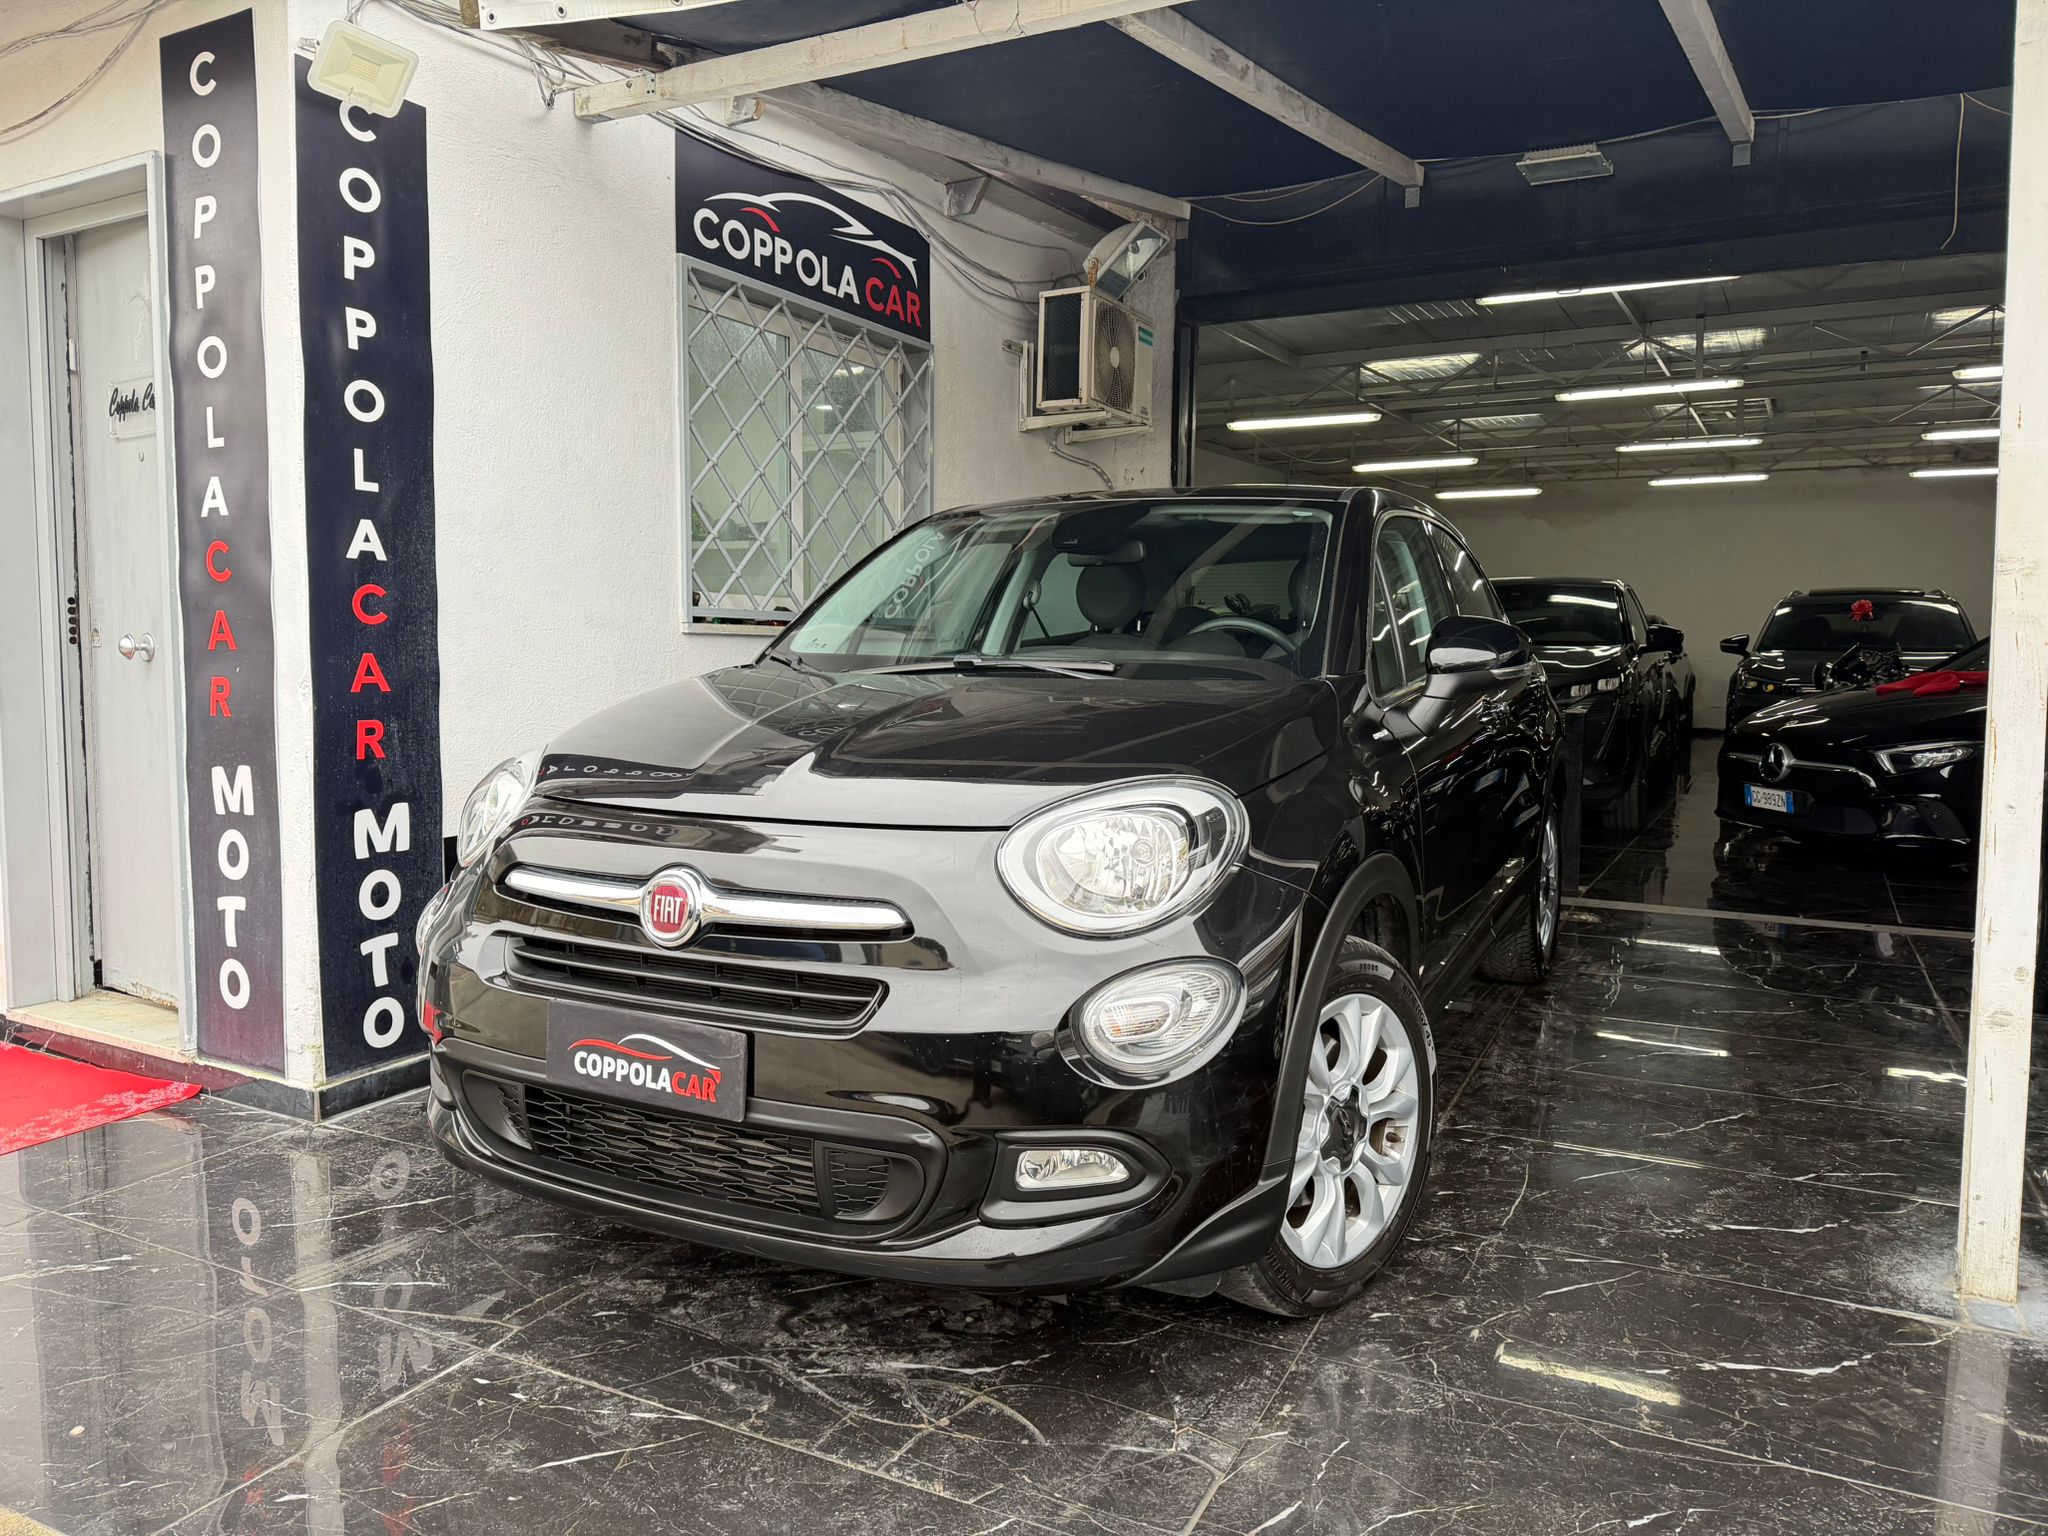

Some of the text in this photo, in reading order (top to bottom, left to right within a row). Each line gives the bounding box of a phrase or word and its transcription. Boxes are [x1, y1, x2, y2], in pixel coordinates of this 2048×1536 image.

[693, 207, 921, 328] COPPOLA CAR
[109, 382, 156, 422] Coppola Ca
[189, 51, 254, 1010] COPPOLA CAR MOTO
[351, 583, 391, 760] CAR
[353, 801, 411, 1049] MOTO
[653, 894, 684, 925] FIAT
